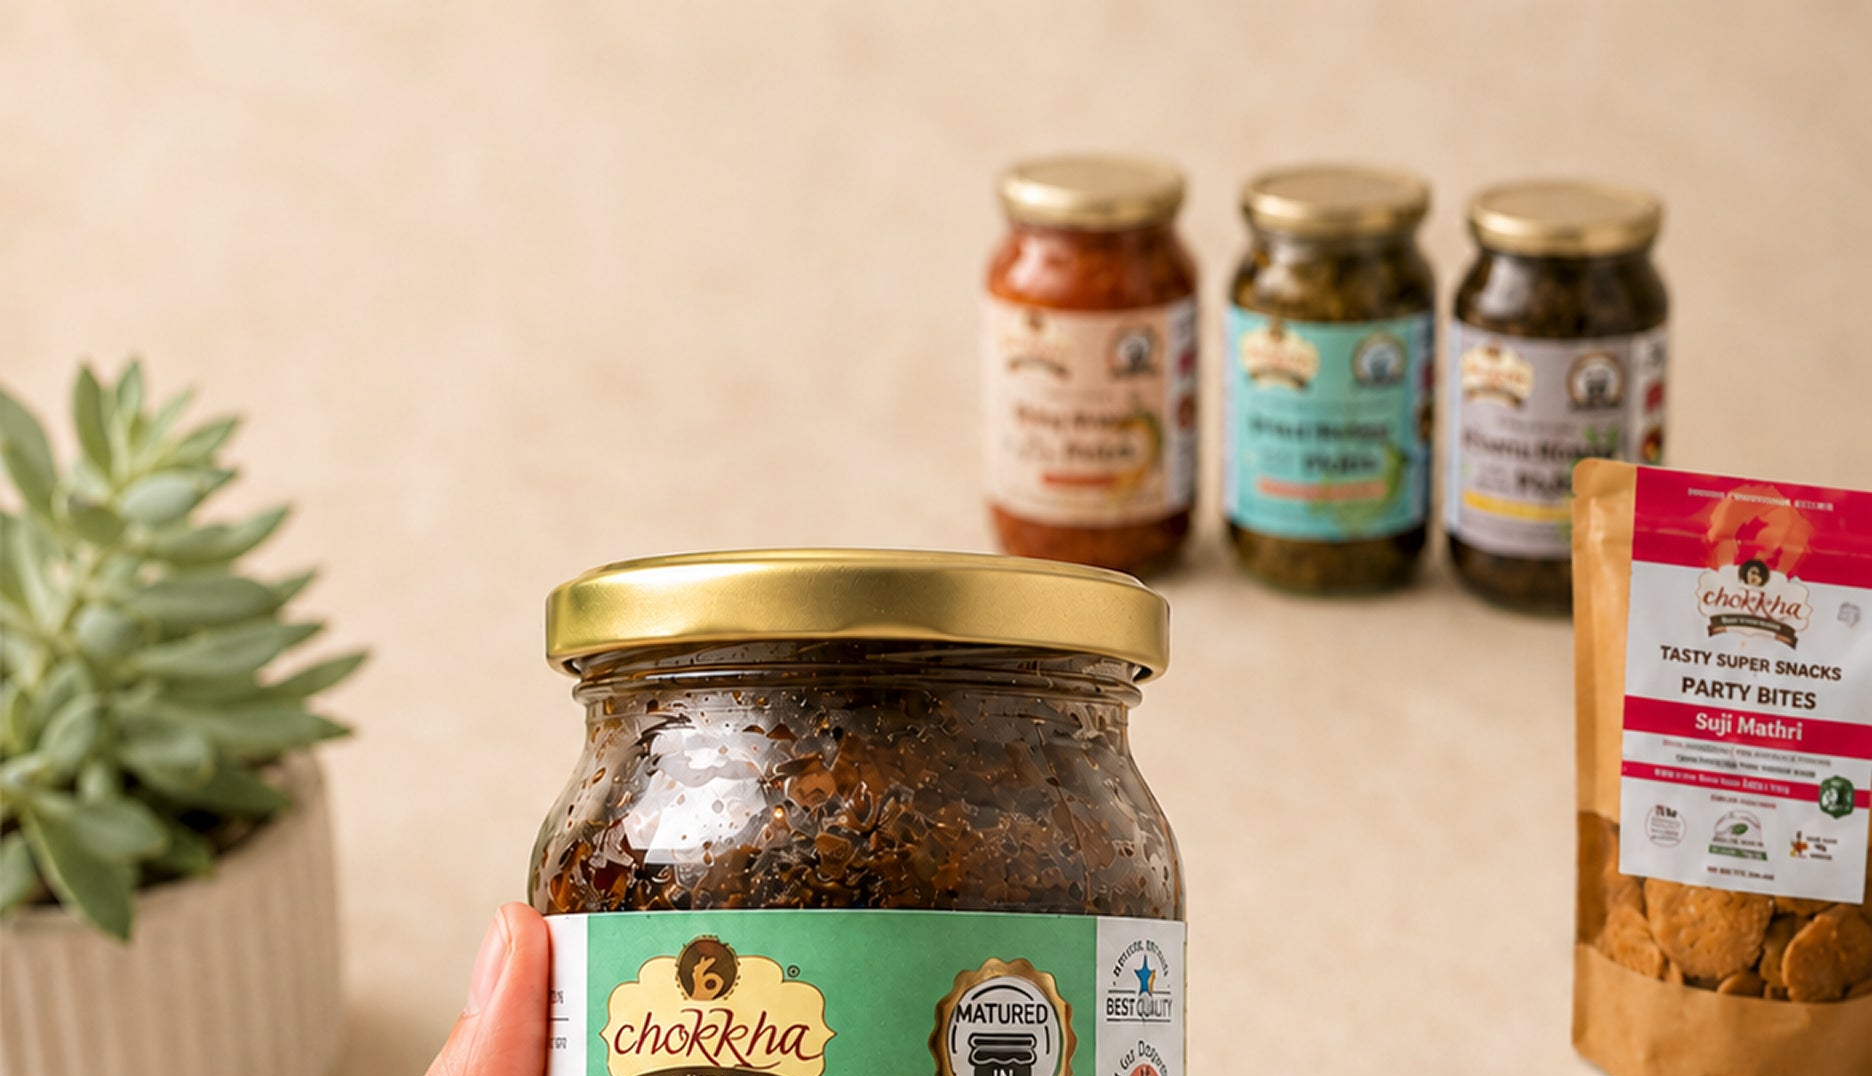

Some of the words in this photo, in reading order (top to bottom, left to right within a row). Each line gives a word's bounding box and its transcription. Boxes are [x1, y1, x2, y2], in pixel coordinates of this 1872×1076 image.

[1702, 586, 1802, 622] chokkha
[1660, 645, 1712, 665] TASTY
[1716, 653, 1770, 674] SUPER
[1774, 660, 1842, 681] SNACKS
[1681, 676, 1751, 702] PARTY
[1756, 686, 1817, 710] BITES
[1695, 712, 1733, 737] Suji
[1736, 715, 1803, 741] Mathri
[956, 1003, 1049, 1025] MATURED
[1106, 997, 1136, 1016] BEST
[613, 1008, 825, 1069] chokkha
